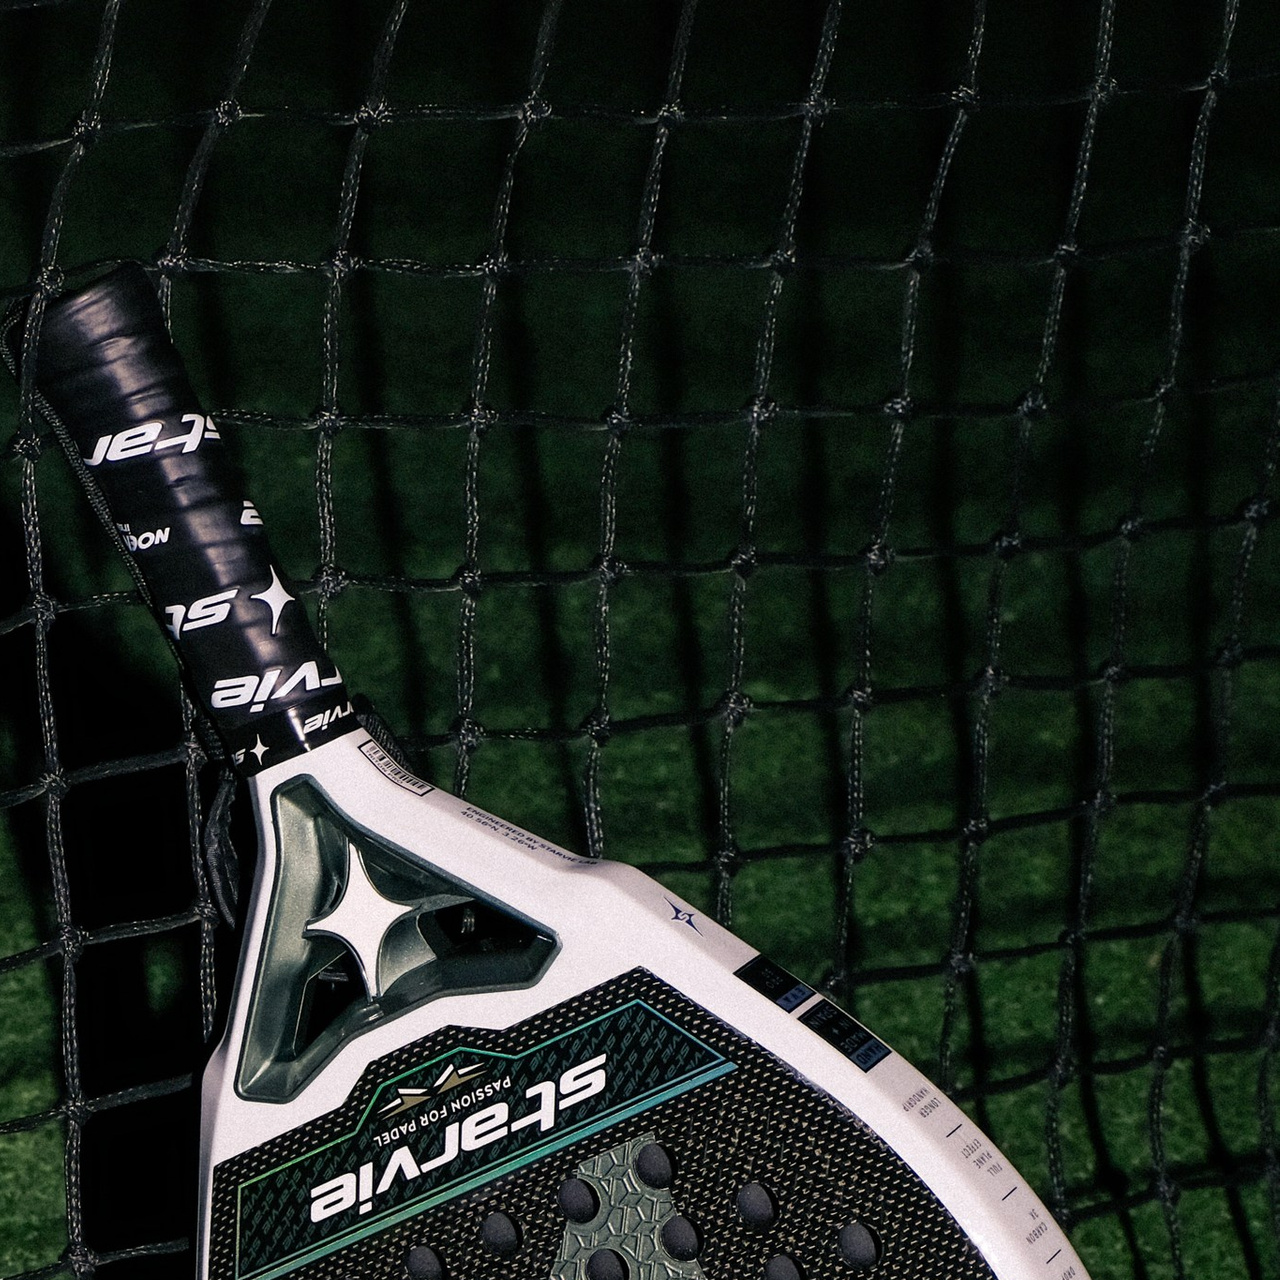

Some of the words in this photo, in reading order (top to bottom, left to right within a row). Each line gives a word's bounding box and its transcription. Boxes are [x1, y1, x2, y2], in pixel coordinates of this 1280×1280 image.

[840, 1031, 868, 1054] MADE
[856, 1043, 885, 1065] HAND
[451, 1075, 512, 1112] PASSION
[419, 1106, 449, 1127] FOR
[919, 1096, 942, 1119] LONGER
[310, 1053, 607, 1223] starvie
[373, 1121, 418, 1148] PADEL
[961, 1138, 982, 1159] EFFECT
[973, 1149, 993, 1169] PLANE
[1025, 1221, 1048, 1245] CARBON
